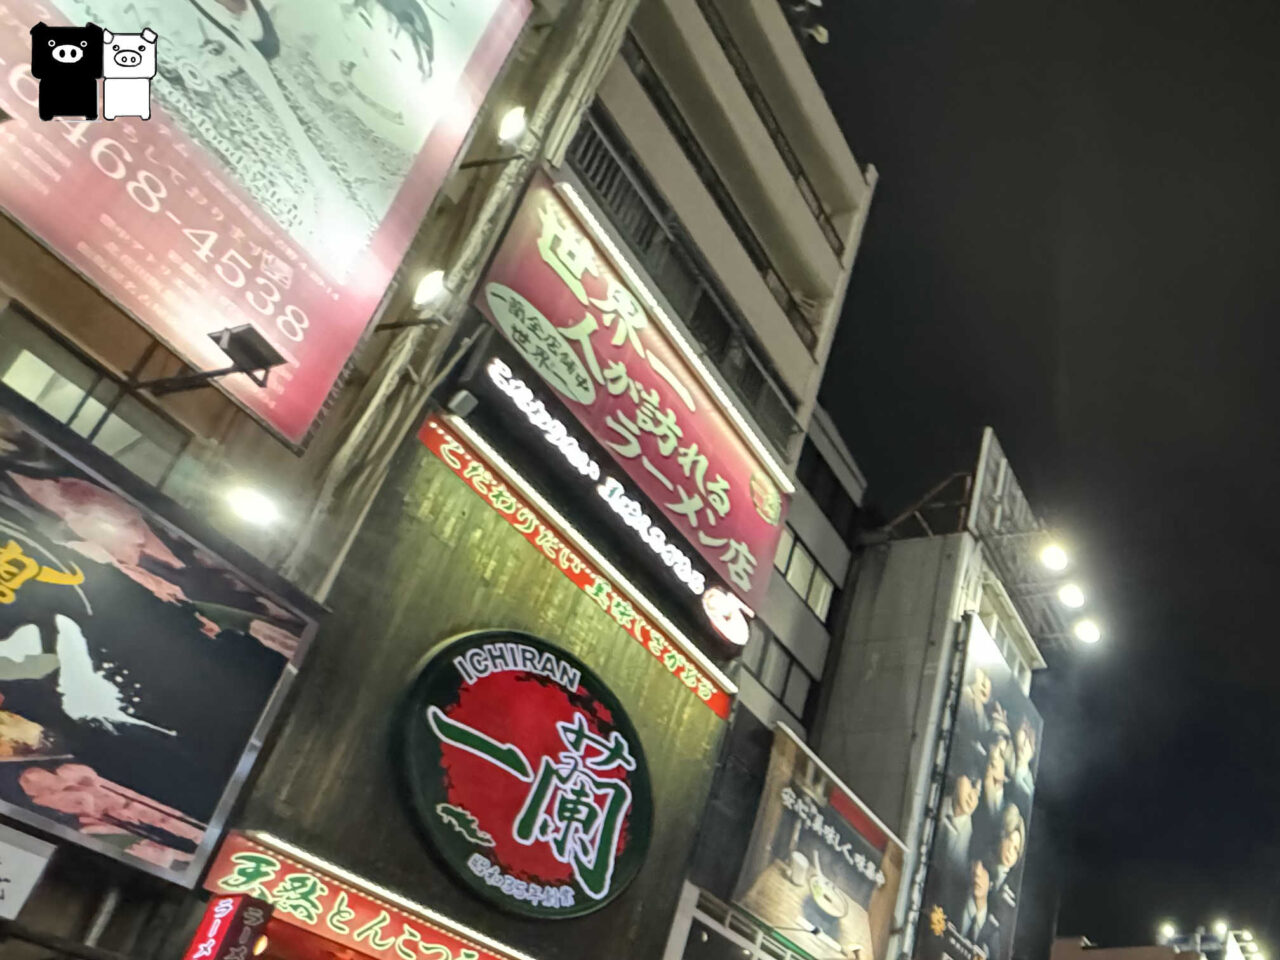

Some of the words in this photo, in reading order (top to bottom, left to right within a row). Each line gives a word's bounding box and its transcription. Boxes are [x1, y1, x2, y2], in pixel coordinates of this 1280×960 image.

[536, 203, 697, 412] 世界一
[558, 312, 731, 518] 人が訪れる
[605, 409, 758, 593] ラーメン店
[454, 644, 583, 692] ICHIRAN
[427, 702, 637, 900] 一蘭
